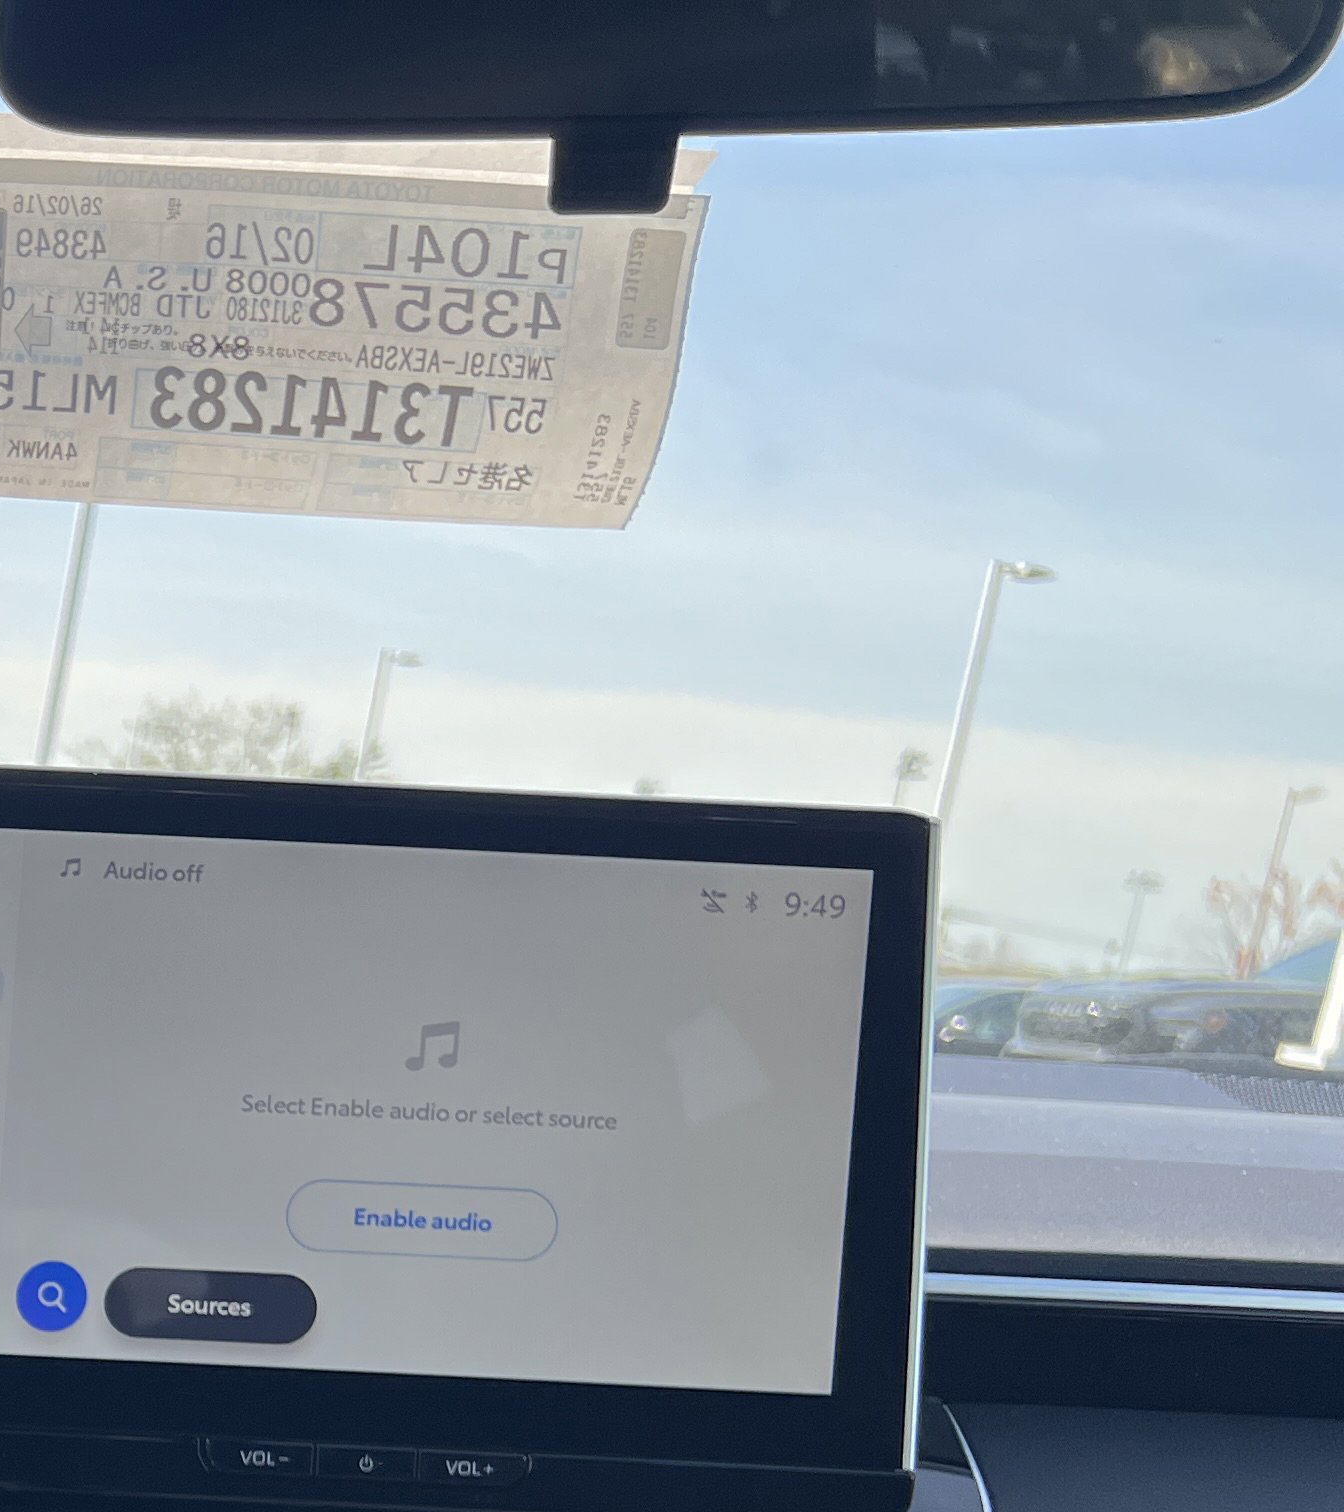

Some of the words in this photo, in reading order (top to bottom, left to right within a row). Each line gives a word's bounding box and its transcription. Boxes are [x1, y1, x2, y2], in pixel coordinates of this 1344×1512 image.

[103, 860, 168, 881] Audio
[173, 863, 205, 883] off
[784, 892, 846, 919] 9:49
[241, 1094, 306, 1116] Select
[311, 1097, 384, 1119] Enable
[389, 1102, 450, 1123] audio
[454, 1108, 476, 1124] or
[483, 1105, 543, 1127] select
[548, 1111, 617, 1131] source
[353, 1207, 426, 1230] Enable
[431, 1211, 493, 1233] audio
[167, 1293, 251, 1317] Sources
